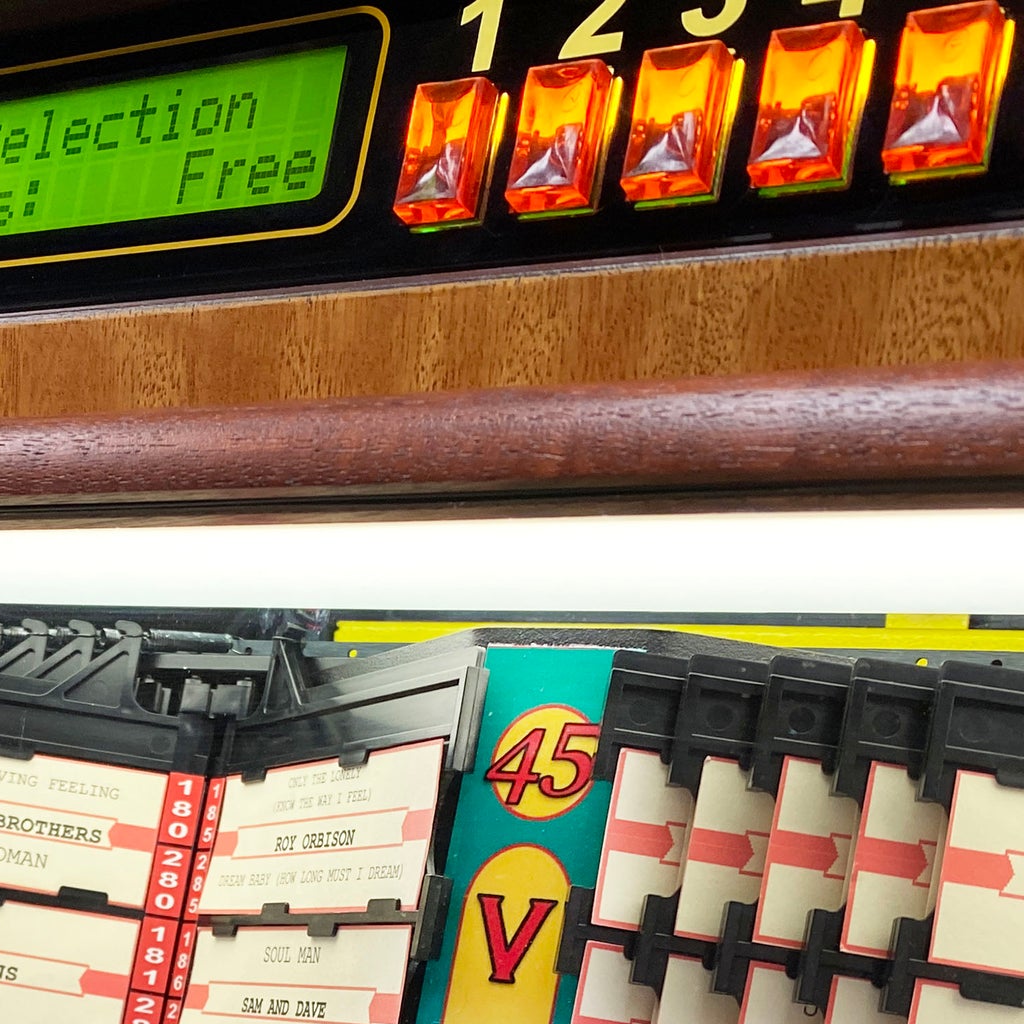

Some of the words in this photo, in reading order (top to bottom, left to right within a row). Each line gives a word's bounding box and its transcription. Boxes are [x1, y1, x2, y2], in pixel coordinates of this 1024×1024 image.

[460, 0, 503, 72] 1
[177, 144, 316, 205] Free
[486, 722, 598, 806] 45
[48, 778, 120, 801] FEELING
[312, 772, 328, 785] THE
[317, 794, 334, 807] WAY
[346, 787, 372, 803] FEEL)
[274, 836, 297, 852] ROY
[302, 829, 356, 849] ORBISON
[218, 874, 245, 887] DREAM
[250, 872, 270, 886] BABY
[275, 872, 295, 886] (HOW
[300, 870, 323, 884] LONG
[328, 868, 352, 882] MUST
[356, 869, 362, 881] I
[368, 864, 404, 881] DREAM)
[264, 946, 291, 963] SOUL
[297, 947, 321, 964] MAN
[241, 998, 262, 1014] SAM
[267, 999, 289, 1017] AND
[296, 1000, 327, 1019] DAVE
